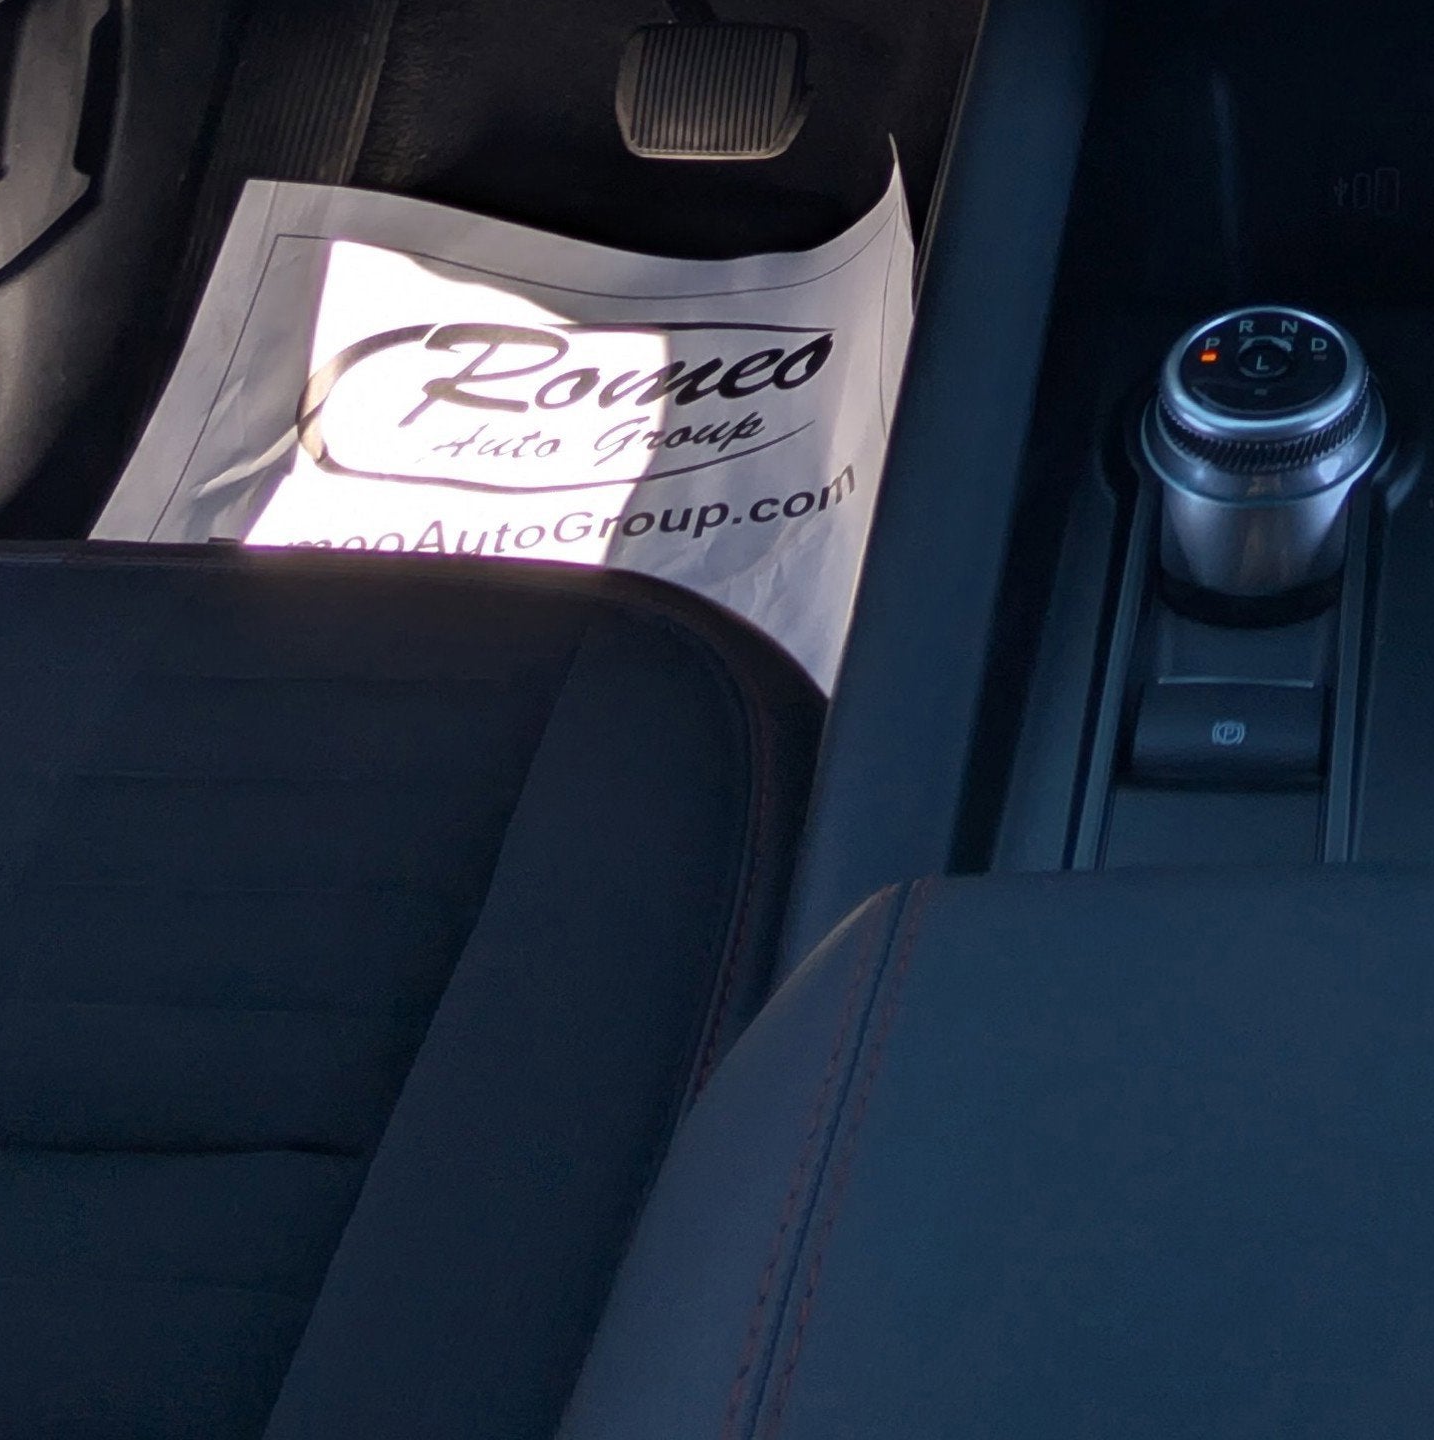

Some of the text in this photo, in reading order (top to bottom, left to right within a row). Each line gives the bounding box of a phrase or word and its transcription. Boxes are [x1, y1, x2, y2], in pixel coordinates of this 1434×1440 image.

[1239, 320, 1298, 334] R N
[1204, 337, 1221, 351] P
[1311, 337, 1327, 352] D
[1256, 355, 1270, 370] L
[398, 322, 834, 428] Romeo
[417, 412, 767, 467] Auto Group
